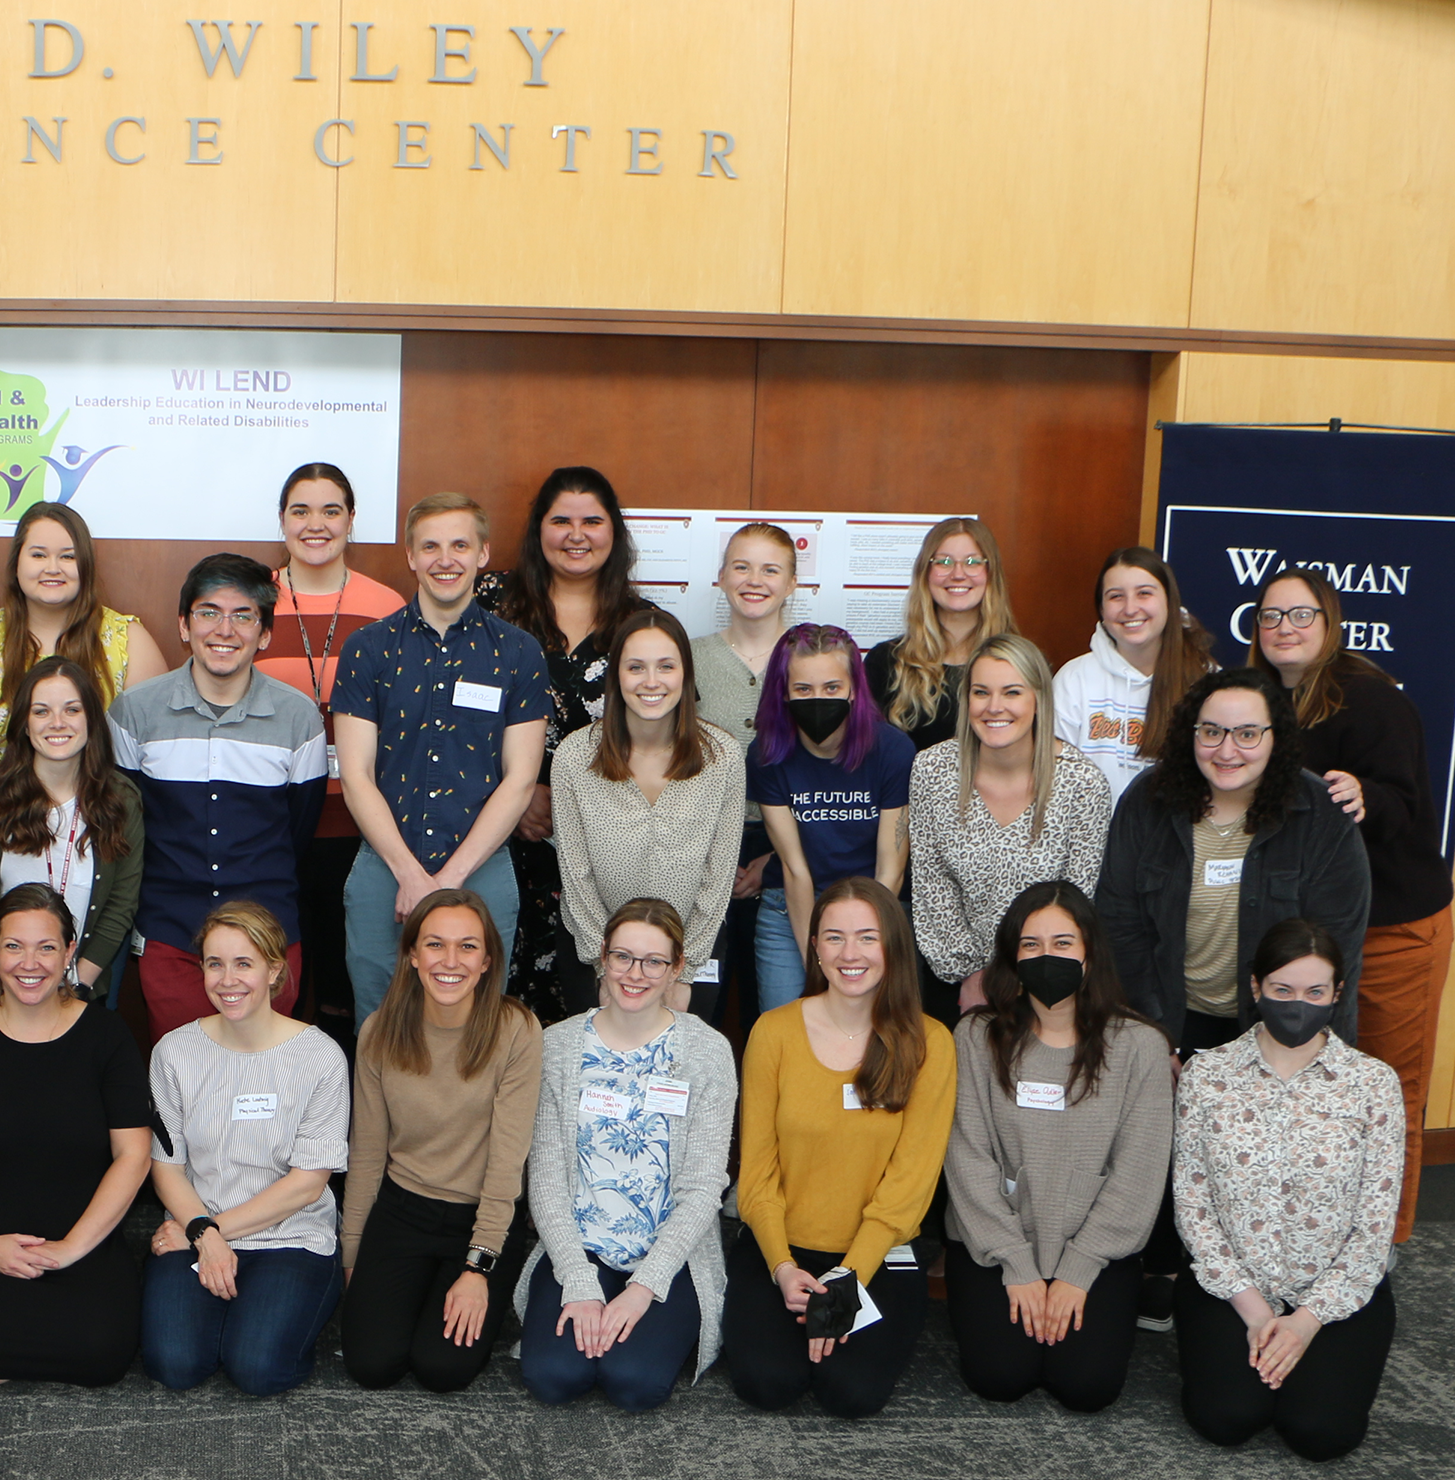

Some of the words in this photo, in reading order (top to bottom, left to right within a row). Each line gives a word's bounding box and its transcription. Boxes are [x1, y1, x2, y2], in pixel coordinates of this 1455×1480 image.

[27, 19, 114, 80] D.
[185, 19, 566, 87] WILEY
[313, 118, 738, 179] CENTER
[171, 369, 205, 391] WI
[215, 369, 292, 393] LEND
[10, 390, 26, 406] &
[75, 395, 151, 410] Leadership
[155, 396, 225, 409] Education
[229, 398, 241, 410] in
[246, 398, 387, 414] Neurodevelopmental
[148, 414, 173, 426] and
[178, 414, 230, 427] Related
[234, 415, 309, 428] Disabilities
[1226, 547, 1411, 595] WMAN
[1230, 602, 1394, 652] CER
[456, 686, 494, 701] Isaac
[790, 792, 811, 805] HE
[814, 791, 871, 803] FUTURE
[586, 1090, 615, 1101] Hannah
[583, 1104, 618, 1117] Audiology
